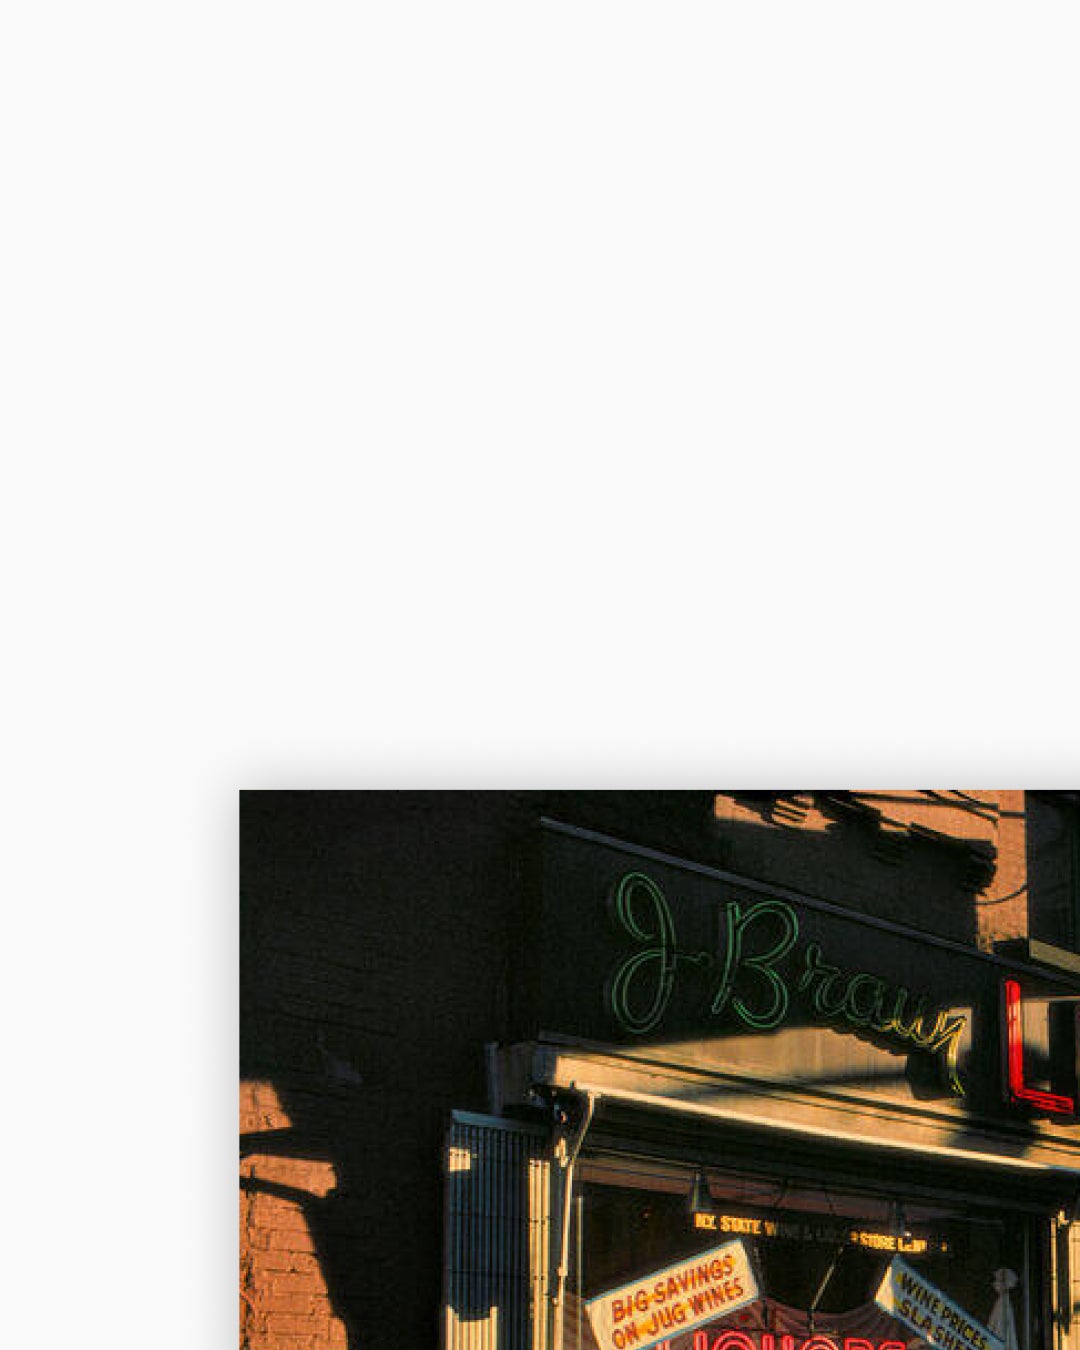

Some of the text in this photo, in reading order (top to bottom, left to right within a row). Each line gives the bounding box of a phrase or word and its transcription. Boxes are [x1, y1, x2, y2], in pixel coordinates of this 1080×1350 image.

[720, 1215, 761, 1235] STATE
[611, 1253, 737, 1323] BIG SAVINGS
[611, 1277, 744, 1350] ON JUG WINES
[901, 1272, 942, 1314] WINE
